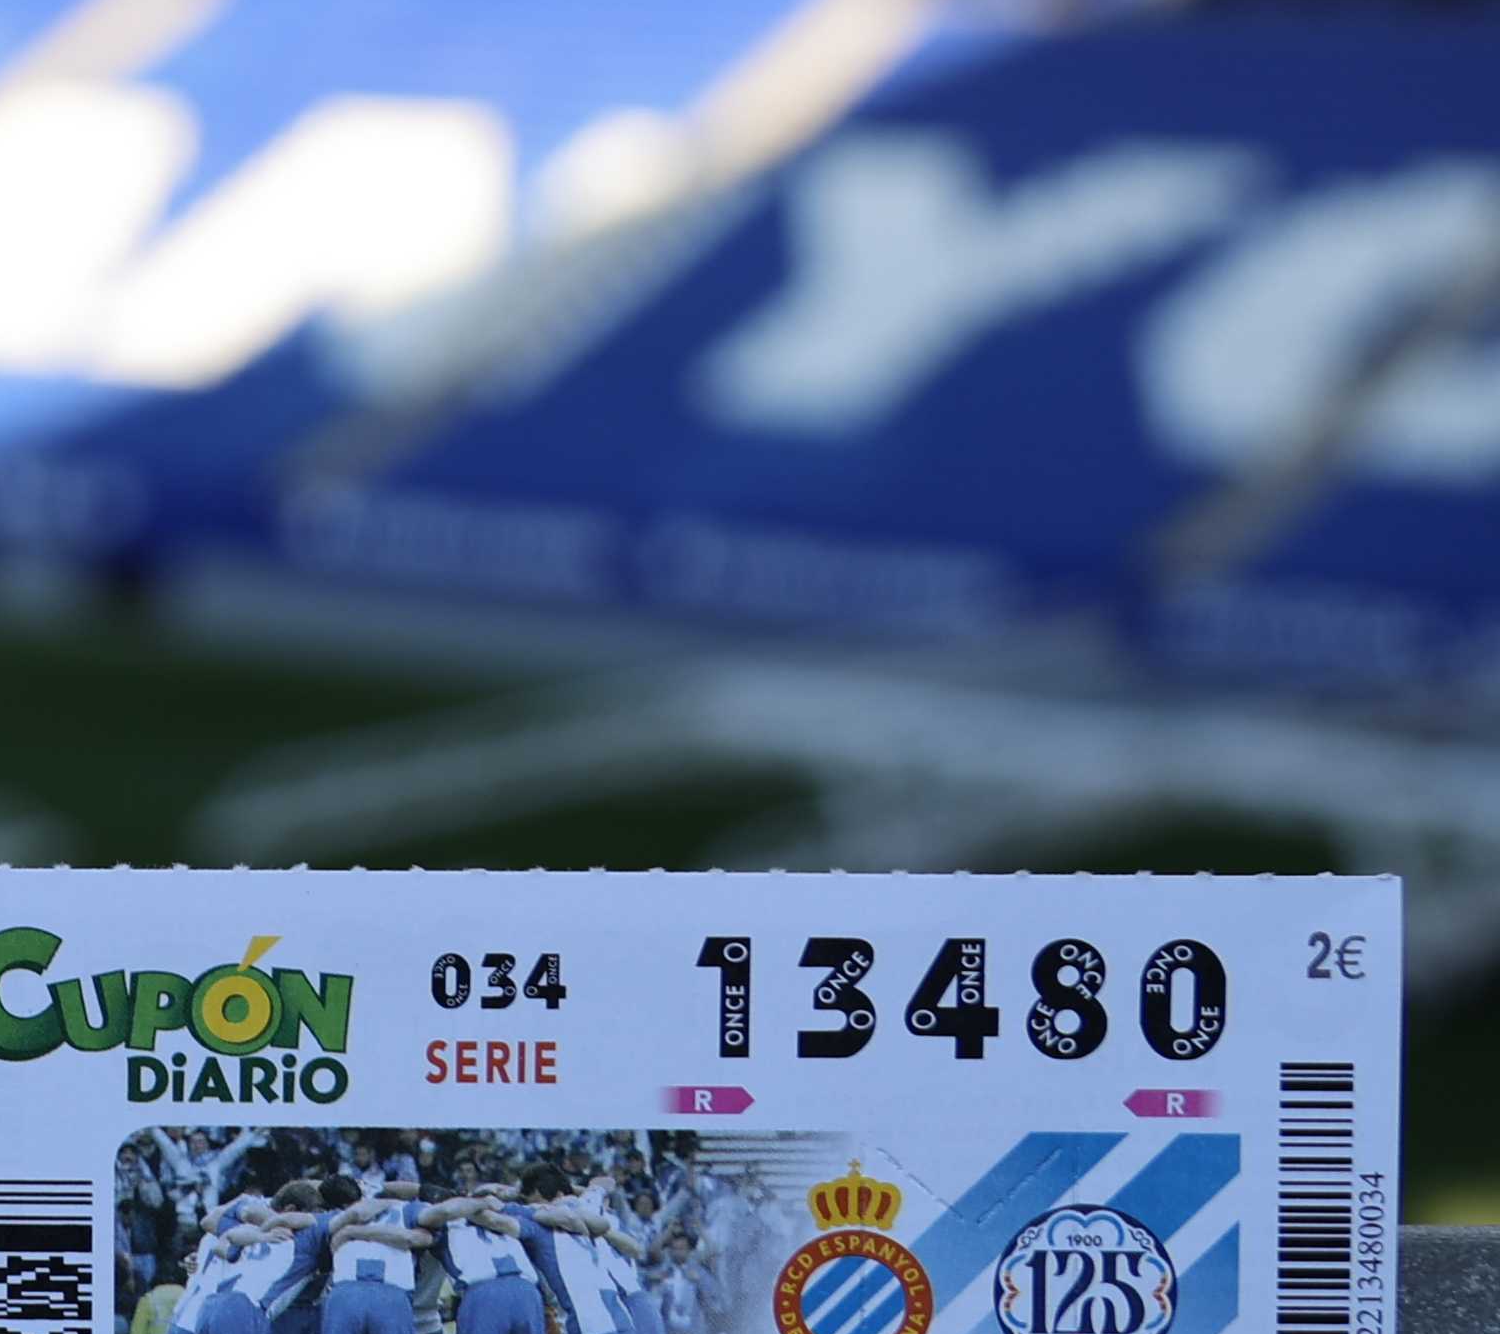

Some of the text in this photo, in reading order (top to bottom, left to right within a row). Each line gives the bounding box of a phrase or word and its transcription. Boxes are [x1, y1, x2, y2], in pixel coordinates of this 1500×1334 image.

[431, 953, 567, 1010] 034
[1307, 931, 1365, 980] 2€
[696, 936, 1228, 1061] 13480
[427, 1039, 559, 1084] SERIE
[1066, 1234, 1103, 1248] 1900
[1025, 1250, 1146, 1334] 125
